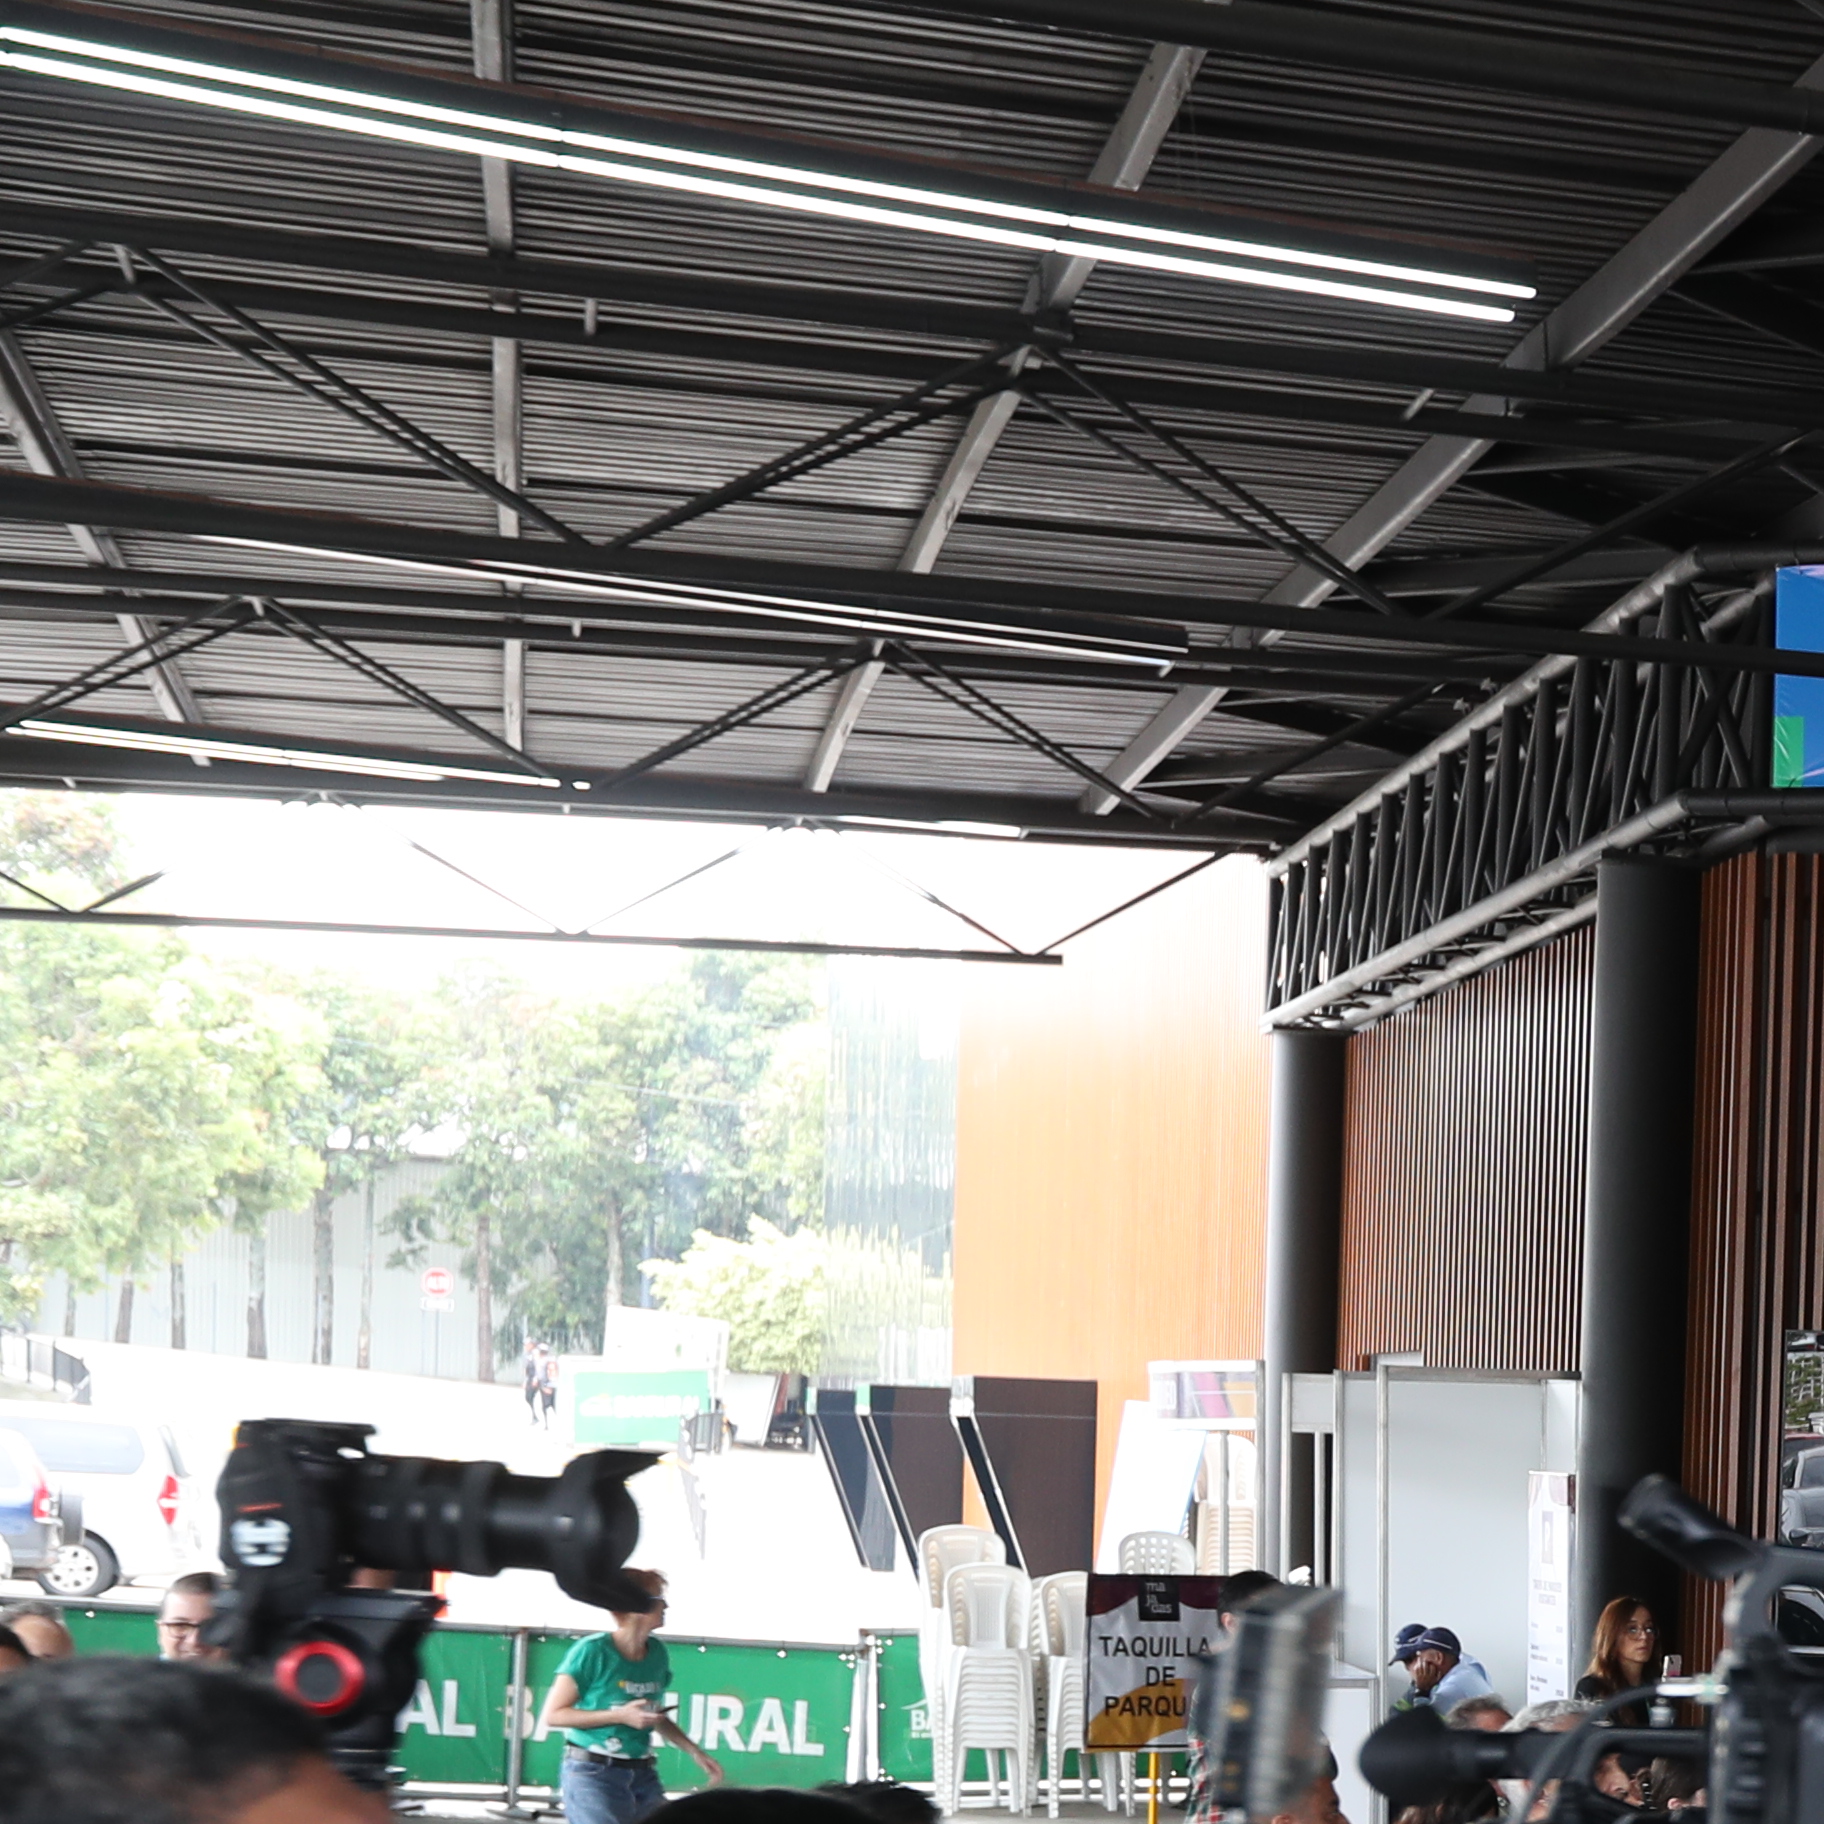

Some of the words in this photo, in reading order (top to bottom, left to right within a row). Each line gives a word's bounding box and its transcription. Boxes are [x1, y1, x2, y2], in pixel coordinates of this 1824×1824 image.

[1098, 1636, 1211, 1658] TAQUILLA
[1145, 1666, 1176, 1687] DE
[1104, 1695, 1187, 1718] PARQU
